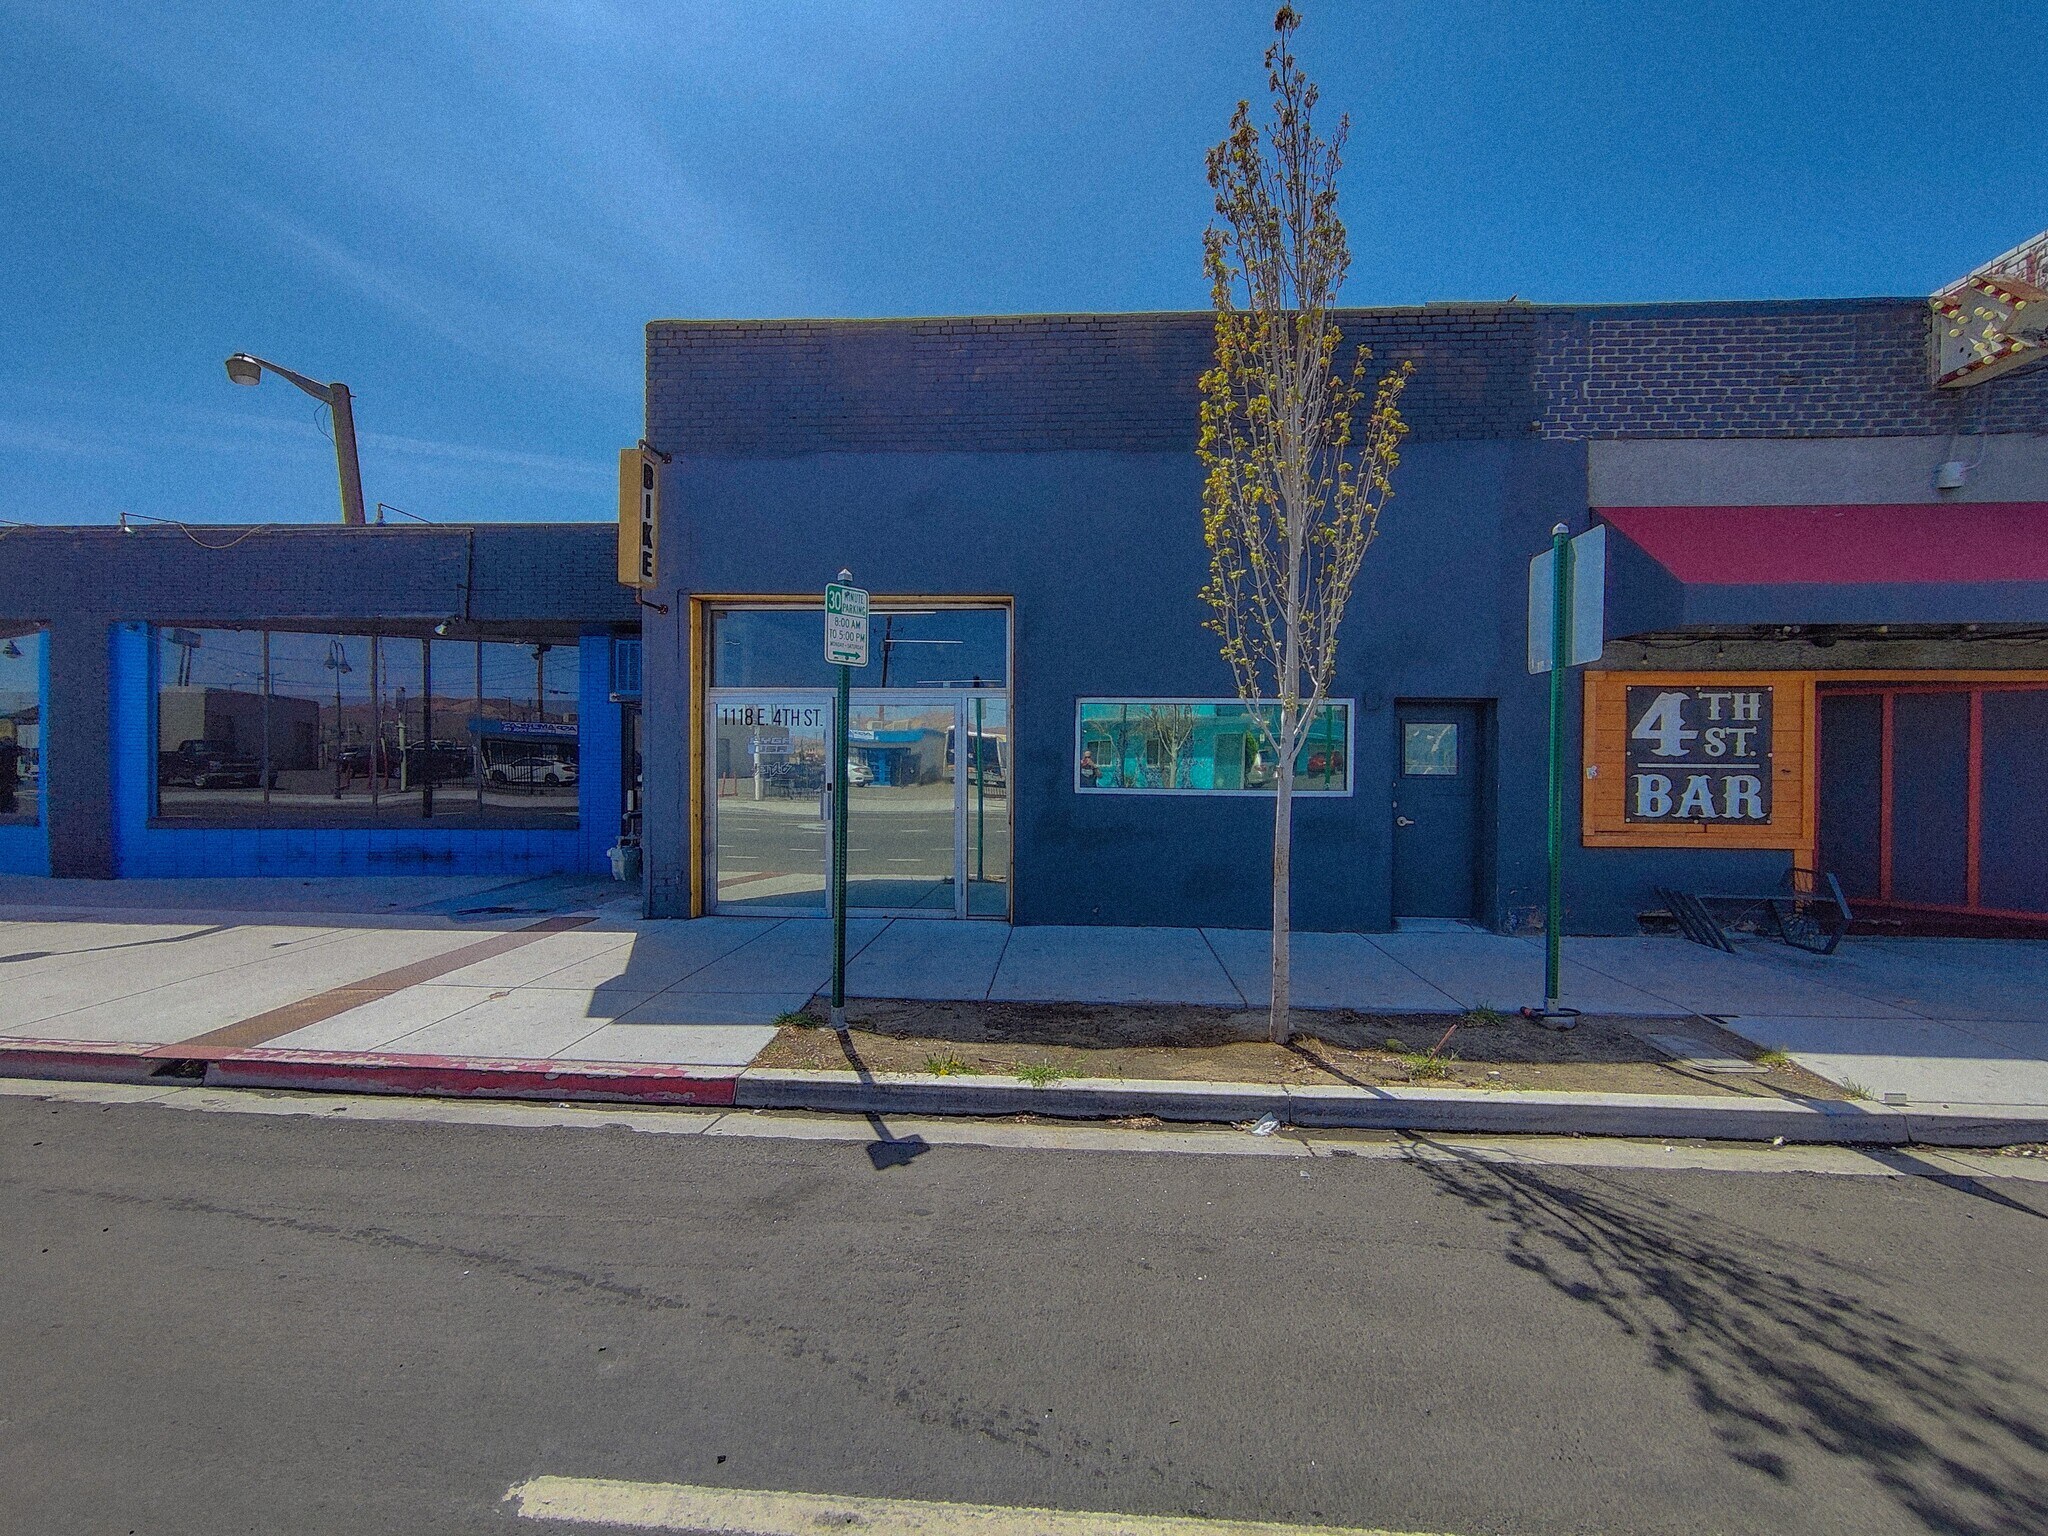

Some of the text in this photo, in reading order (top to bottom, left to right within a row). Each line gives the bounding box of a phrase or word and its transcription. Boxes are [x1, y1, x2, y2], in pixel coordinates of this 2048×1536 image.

[642, 463, 654, 578] BIKE
[829, 590, 841, 610] 30
[843, 603, 866, 616] PARKING
[834, 617, 861, 629] 8:00 AM
[829, 628, 866, 643] TO 5:00 PM
[723, 708, 824, 727] 1118 E. 4TH ST.
[1704, 726, 1758, 757] ST.
[1629, 773, 1768, 819] BAR
